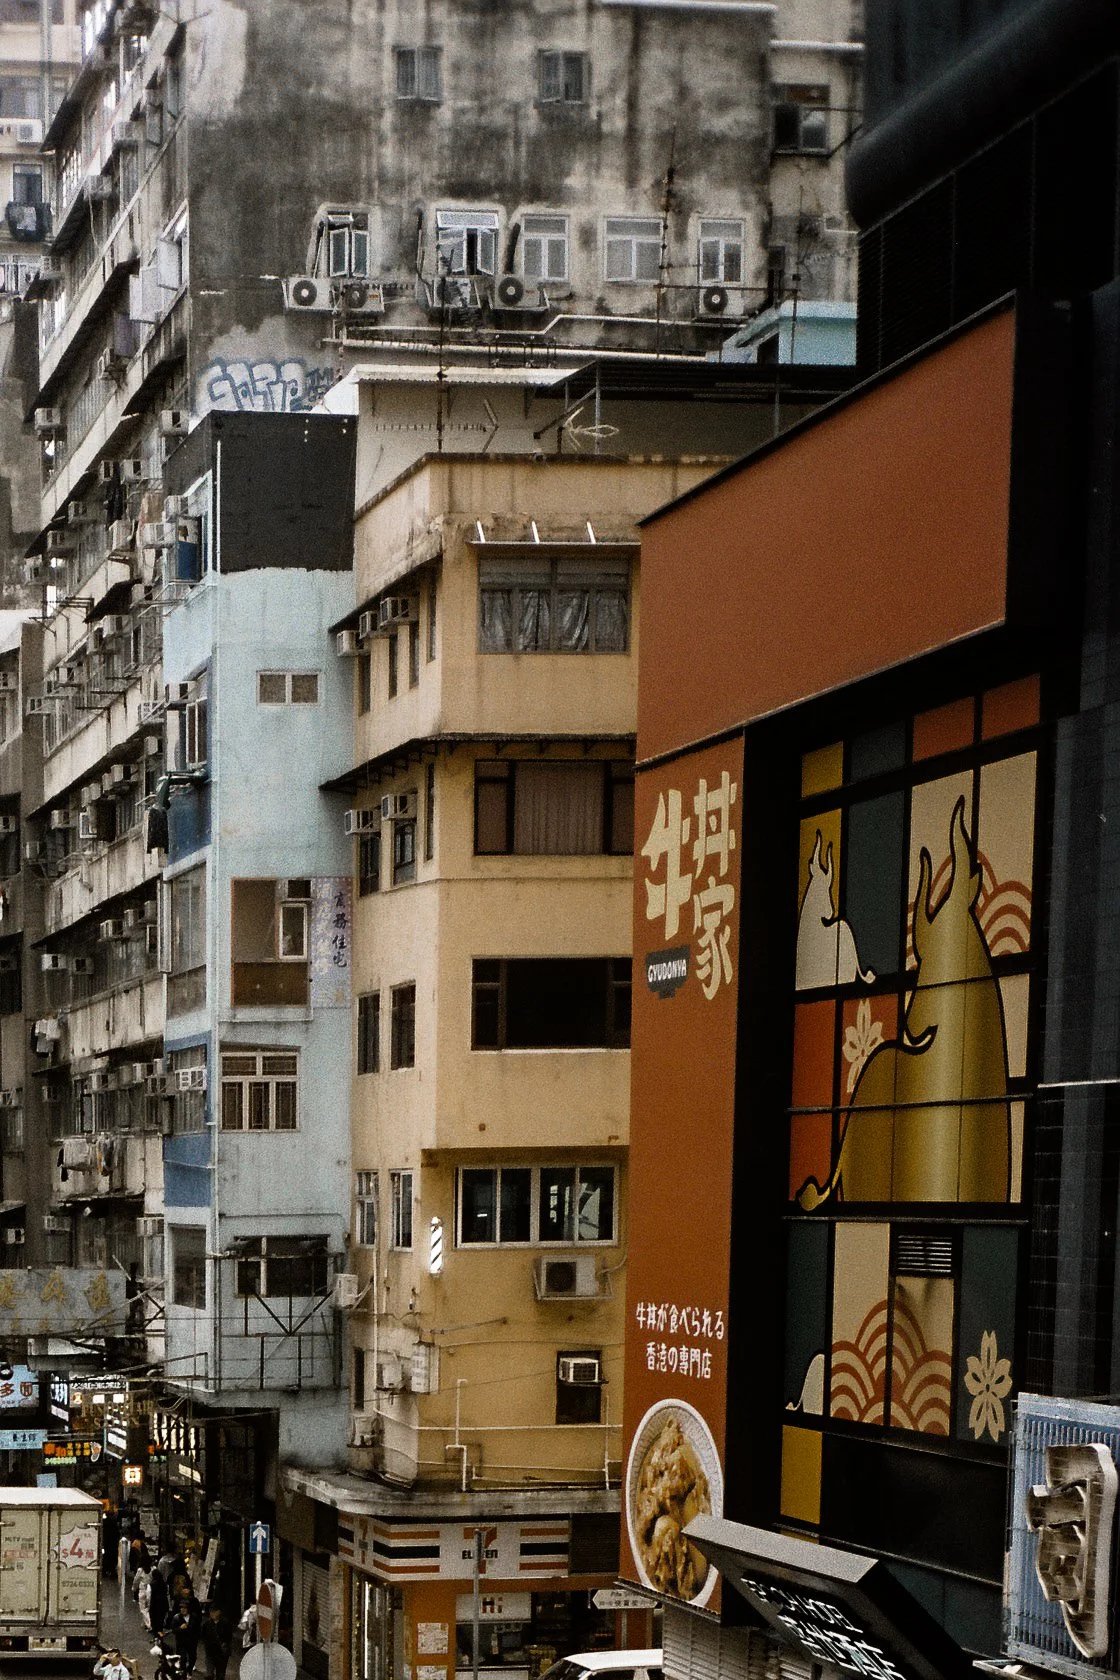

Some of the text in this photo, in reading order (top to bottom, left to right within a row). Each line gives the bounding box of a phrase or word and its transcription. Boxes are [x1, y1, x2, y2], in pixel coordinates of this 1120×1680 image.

[640, 770, 738, 1001] 牛丼家
[647, 958, 687, 983] GYUDONYA
[636, 1302, 724, 1340] 牛丼が食べられる
[795, 1595, 864, 1633] HOTEL
